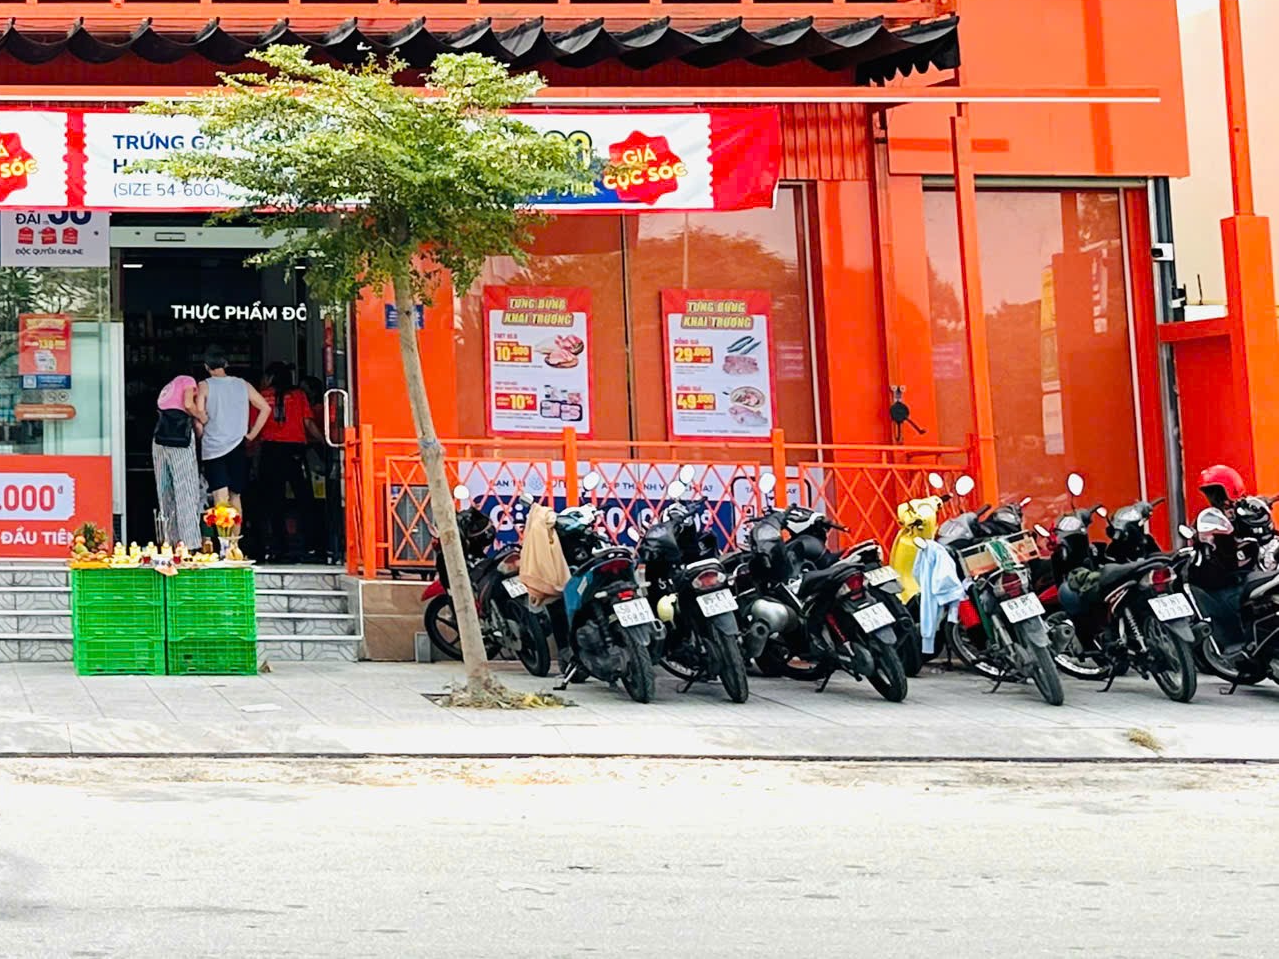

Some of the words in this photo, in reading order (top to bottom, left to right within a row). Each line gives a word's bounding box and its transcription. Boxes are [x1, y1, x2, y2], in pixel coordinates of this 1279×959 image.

[112, 130, 184, 150] TRỨNG
[622, 144, 658, 165] GIÁ
[0, 154, 38, 179] SỐC
[113, 181, 152, 198] (SIZE
[171, 303, 220, 323] THỰC
[224, 301, 278, 321] PHẨM
[1, 527, 38, 545] ĐẦU
